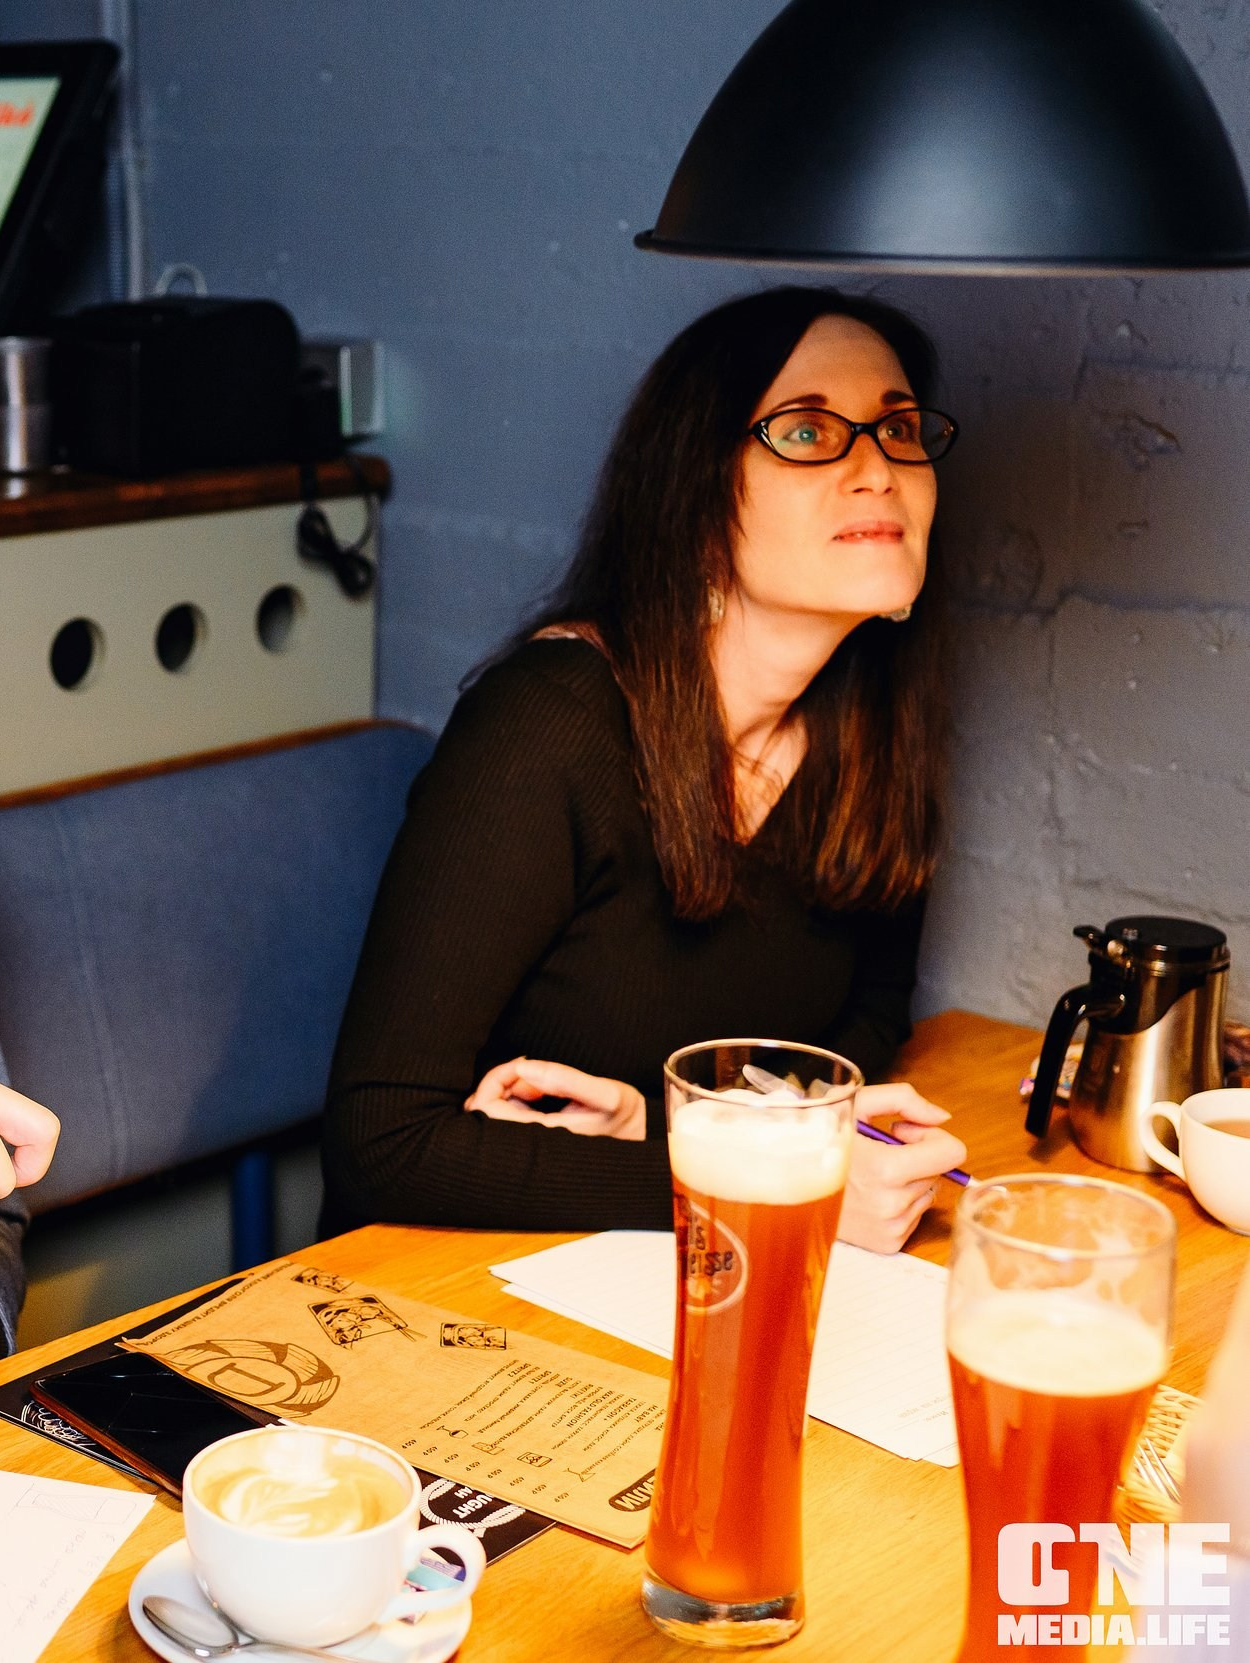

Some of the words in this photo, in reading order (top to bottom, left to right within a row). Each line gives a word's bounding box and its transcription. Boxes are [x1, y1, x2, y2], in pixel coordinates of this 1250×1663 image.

[589, 1398, 603, 1407] OLD
[566, 1406, 592, 1428] FASHION
[452, 1494, 494, 1519] UGHT
